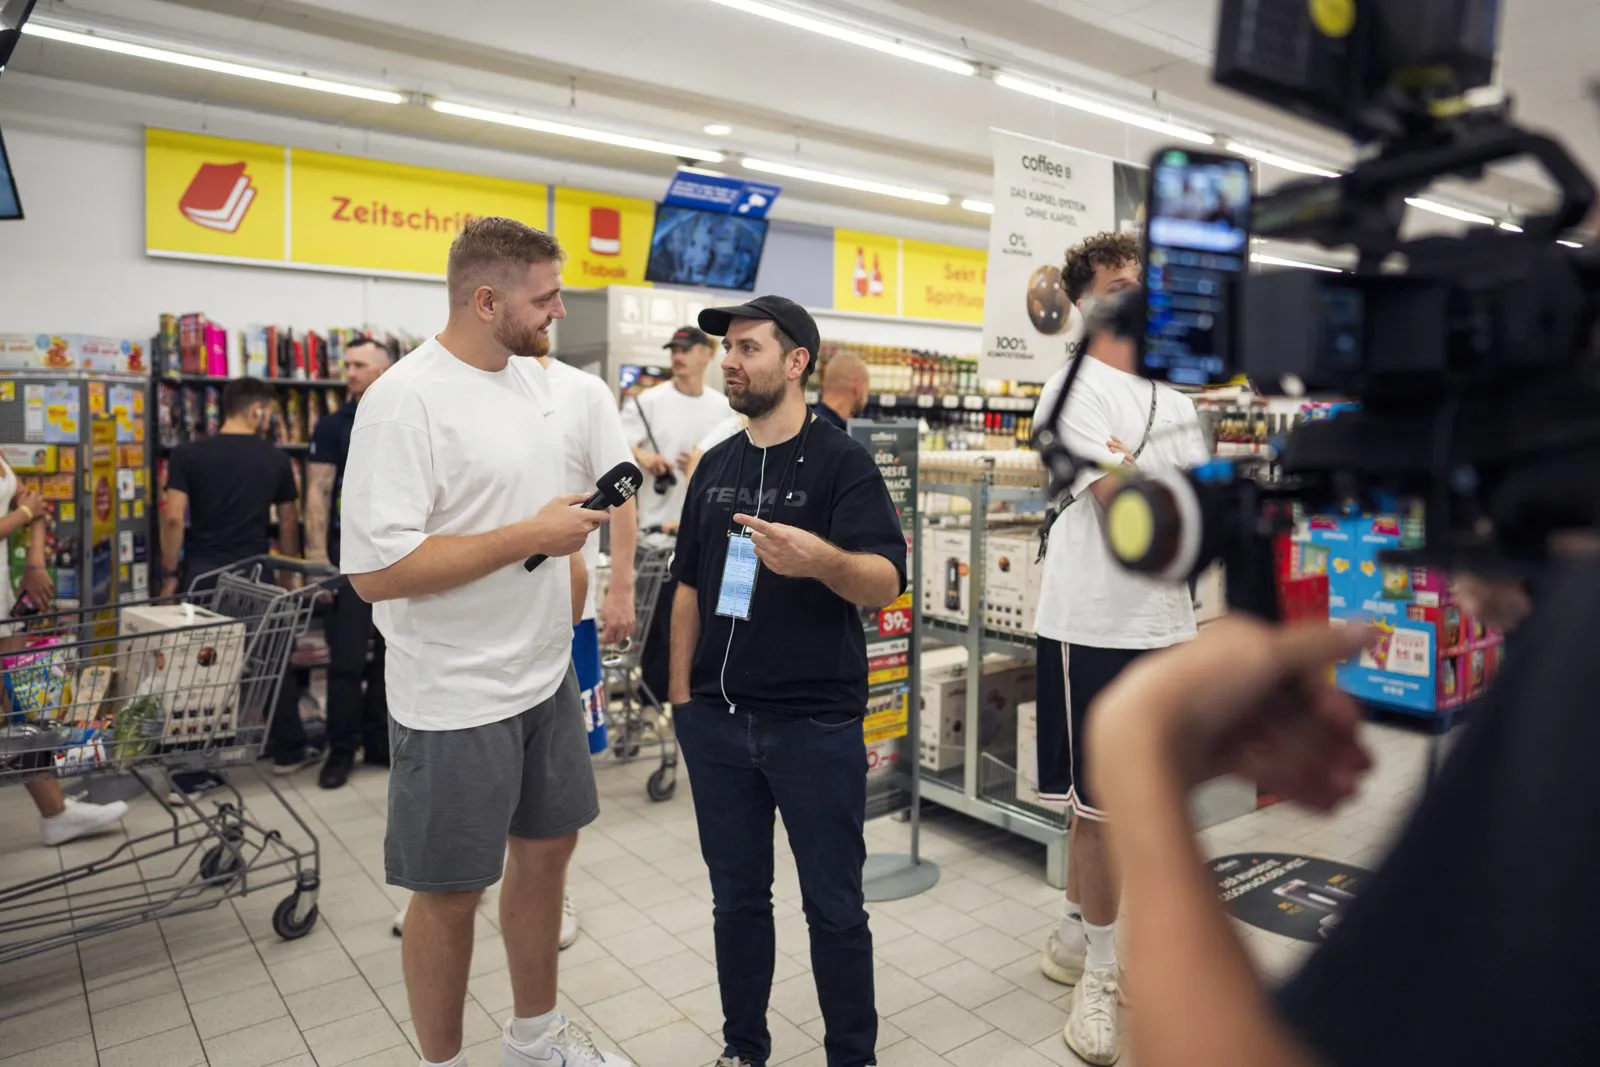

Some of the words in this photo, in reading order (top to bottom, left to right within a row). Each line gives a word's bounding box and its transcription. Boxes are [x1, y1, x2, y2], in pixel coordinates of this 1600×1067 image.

[1021, 154, 1063, 178] coffee
[1010, 186, 1027, 200] DAS
[1009, 233, 1027, 248] 0%
[580, 259, 627, 279] Tabak
[996, 335, 1028, 352] 100%
[706, 487, 778, 506] TEAM
[783, 490, 808, 507] D
